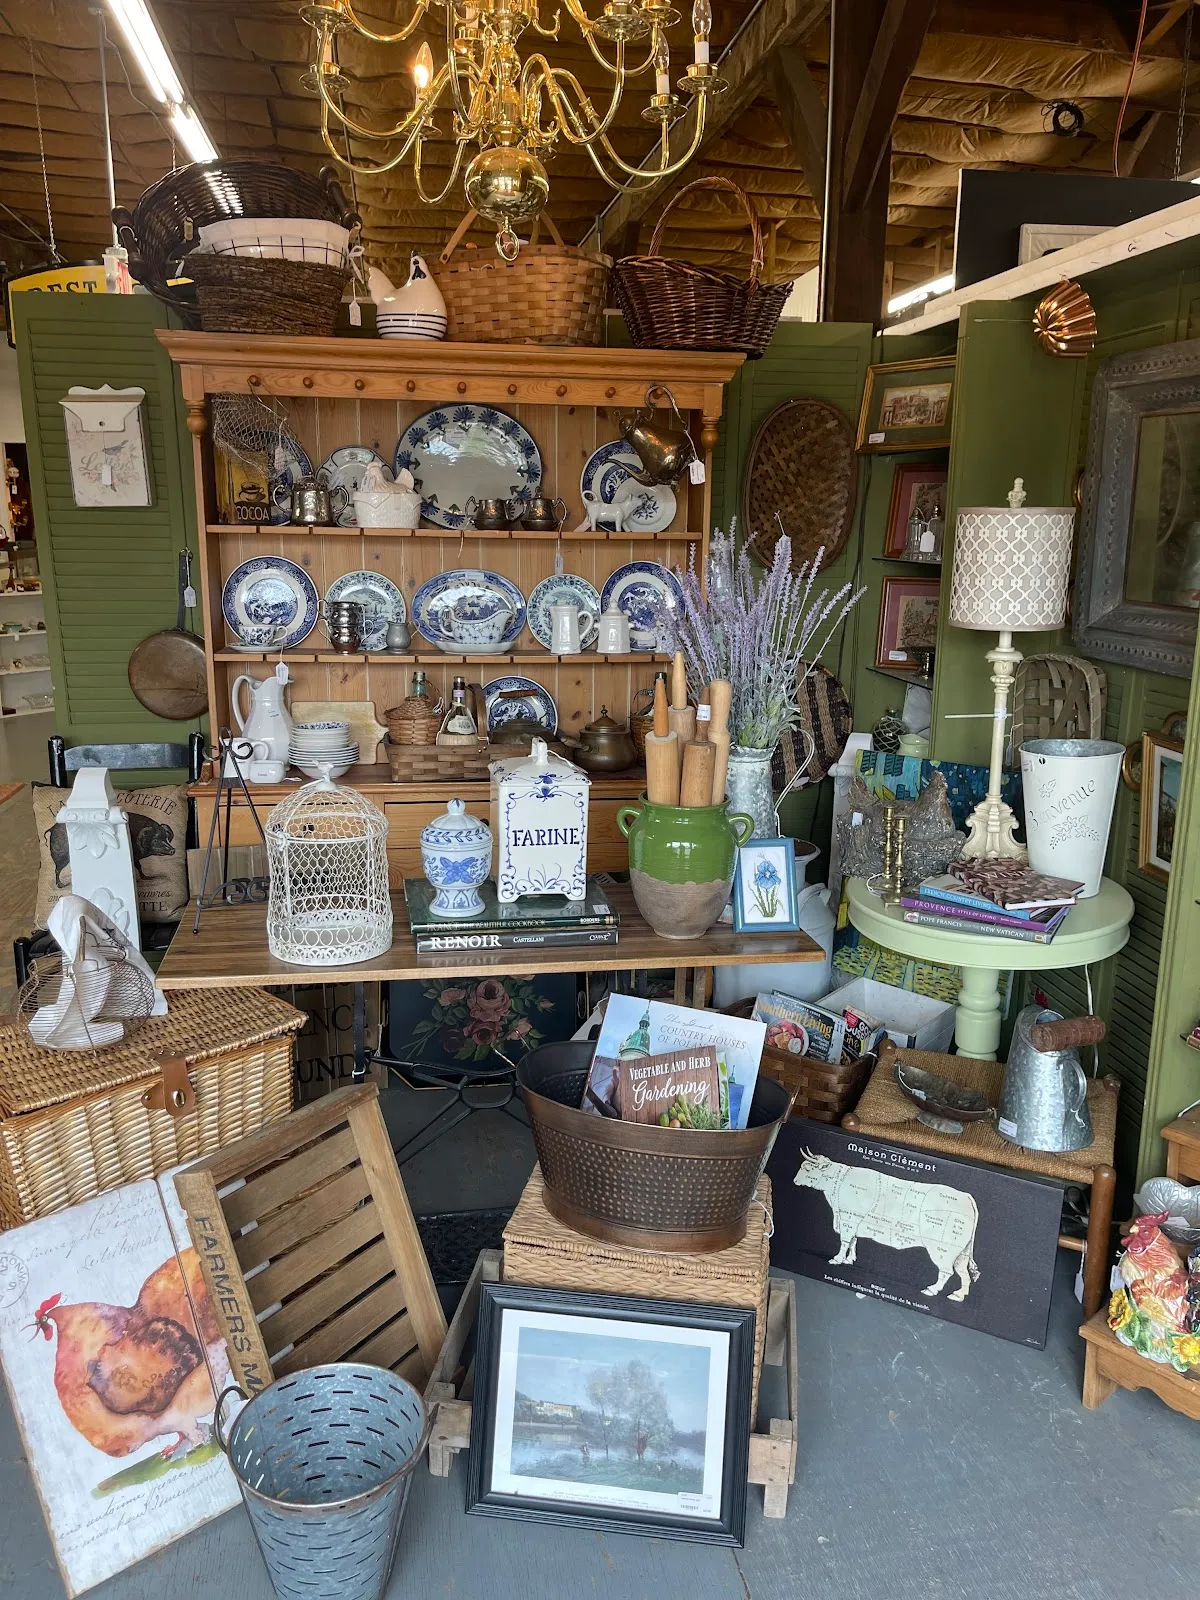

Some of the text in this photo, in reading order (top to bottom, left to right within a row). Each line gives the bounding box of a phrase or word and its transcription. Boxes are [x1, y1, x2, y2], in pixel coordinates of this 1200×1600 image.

[512, 828, 580, 846] FARINE
[914, 900, 956, 914] PROVENCE
[979, 913, 997, 921] LIVING
[920, 915, 935, 923] POPE
[936, 919, 963, 928] FRANCIS
[996, 928, 1025, 938] VATICAN
[430, 934, 502, 949] RENOIR
[803, 1009, 833, 1040] Living
[658, 1035, 671, 1044] OF
[661, 1025, 747, 1050] COUNTRY HOUSES
[629, 1056, 711, 1081] VEGETABLE AND HERB
[632, 1077, 711, 1111] Gardening
[847, 1143, 887, 1160] Maison
[891, 1153, 937, 1172] Clément
[195, 1216, 252, 1353] FARMERS
[823, 1273, 833, 1281] Les
